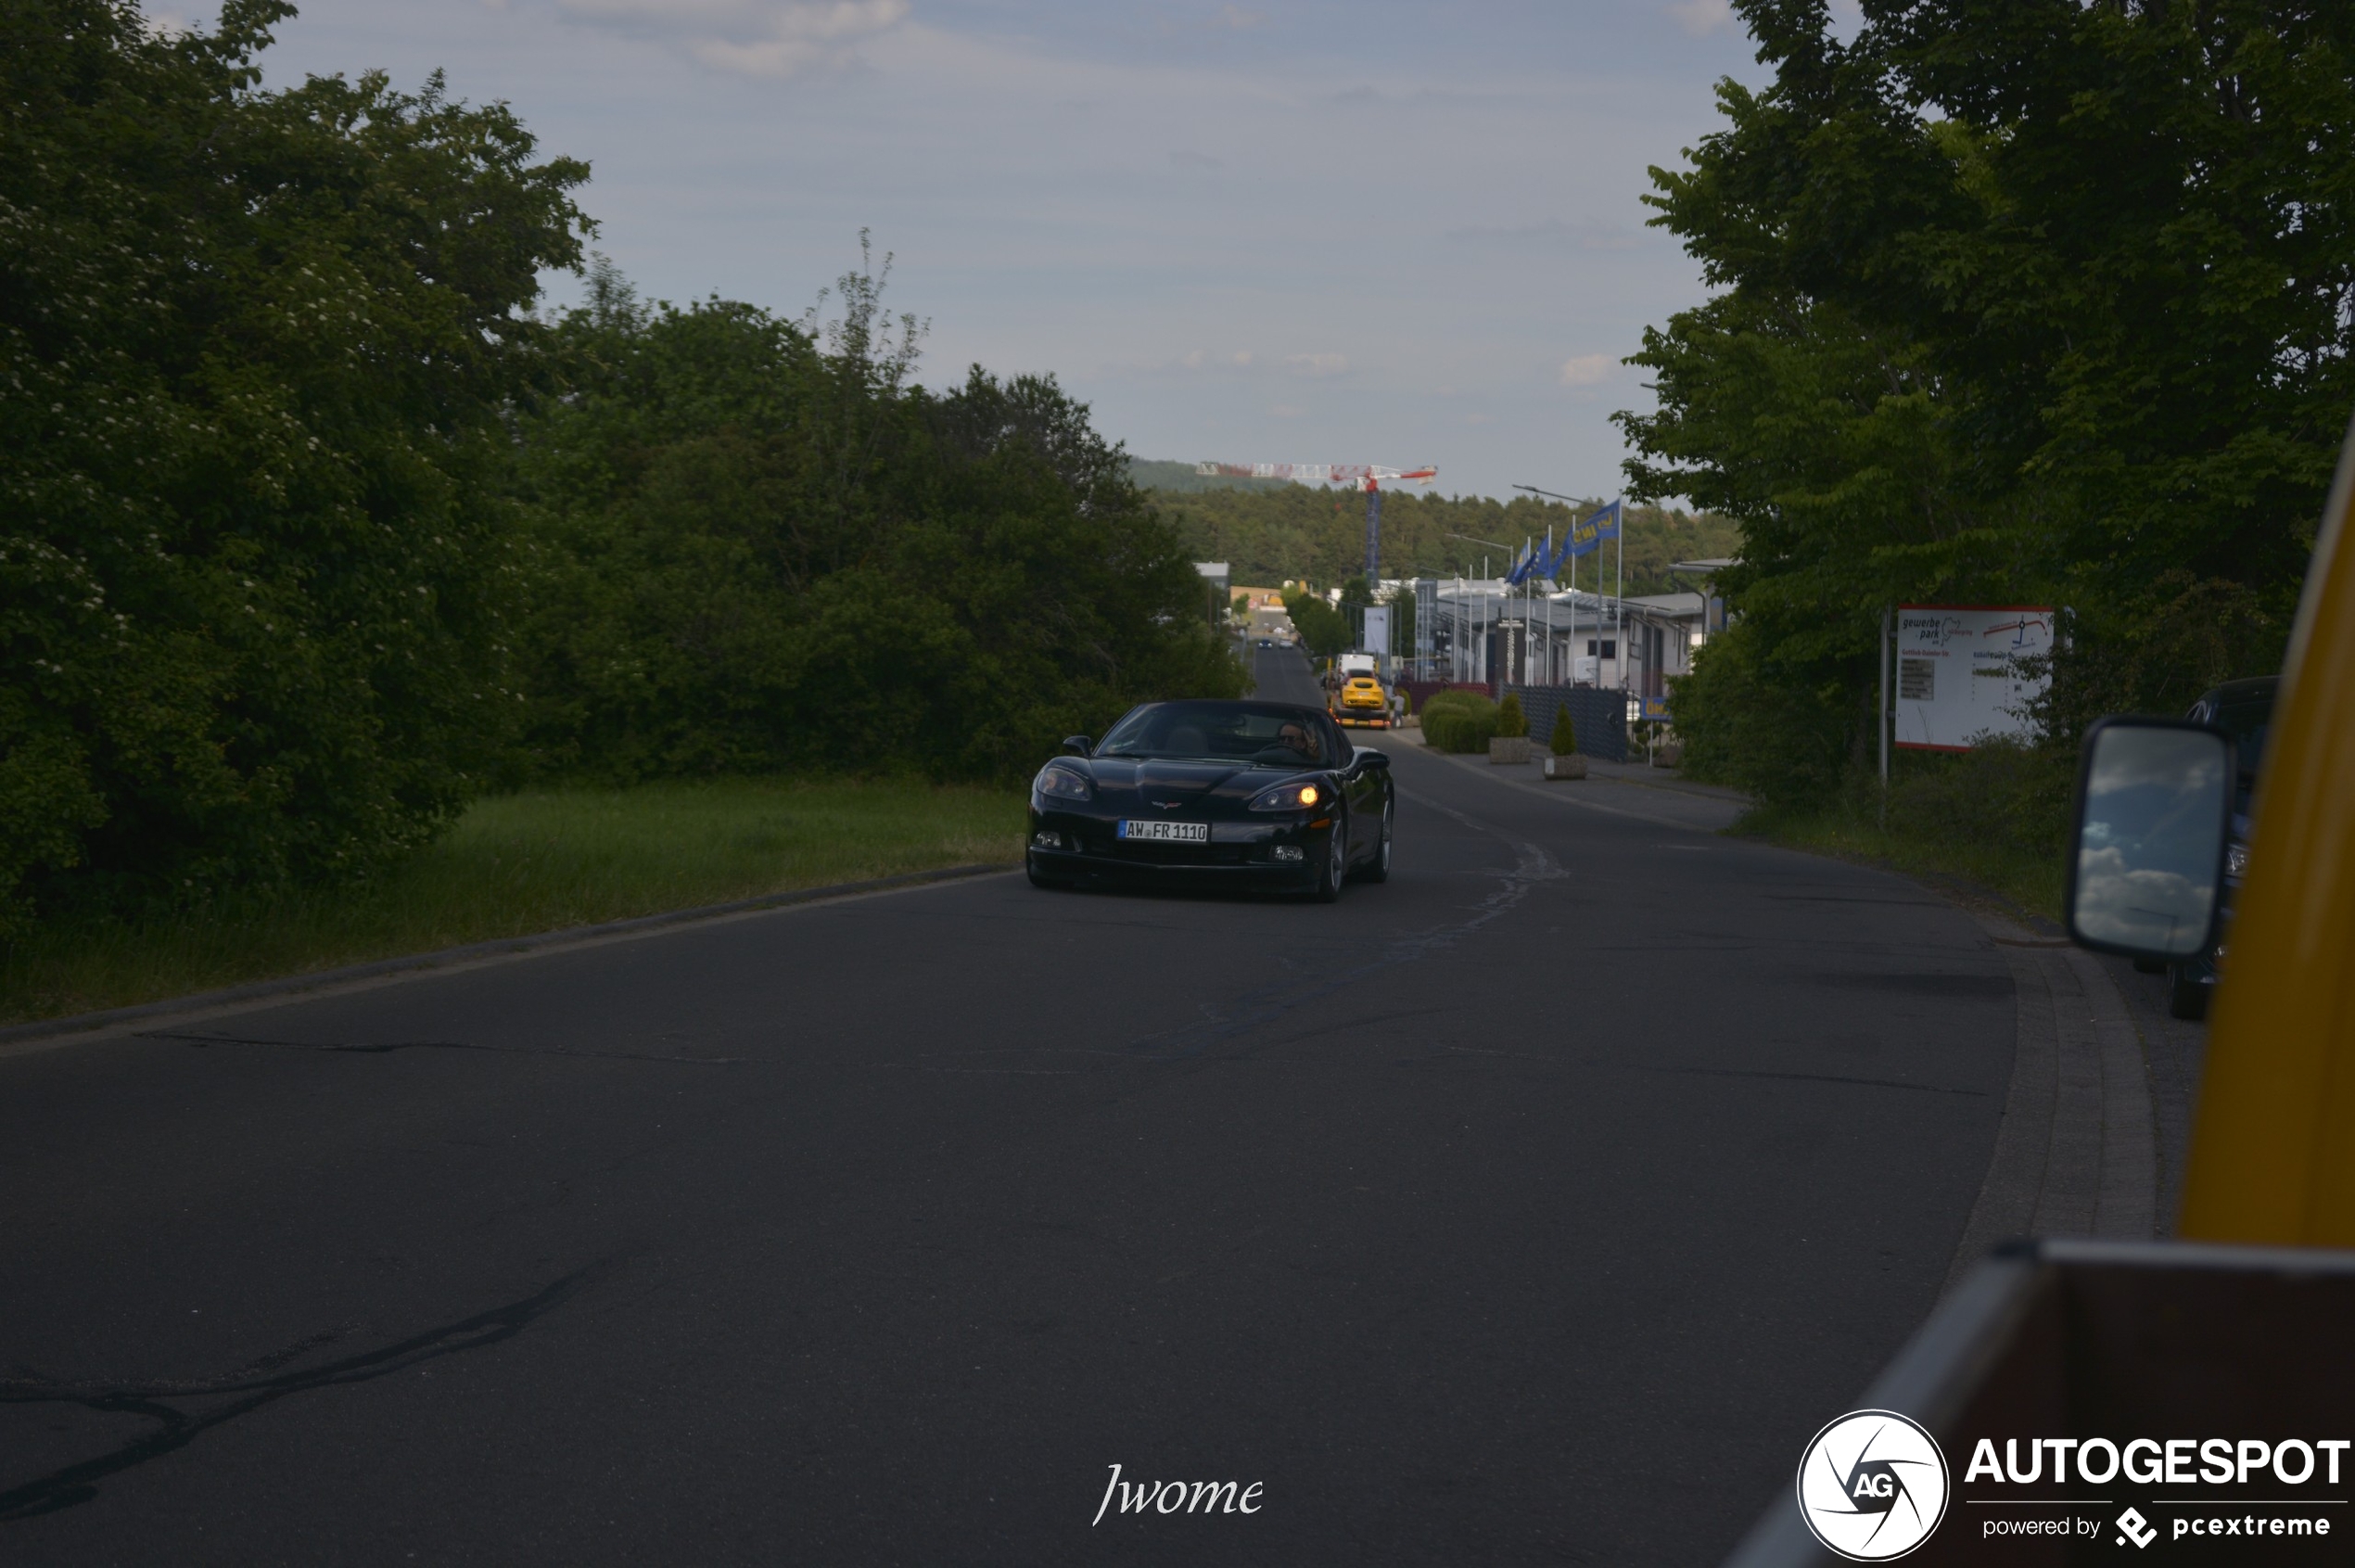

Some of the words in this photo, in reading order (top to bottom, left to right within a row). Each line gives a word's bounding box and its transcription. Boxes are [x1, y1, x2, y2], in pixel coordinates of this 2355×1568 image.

[1903, 617, 1941, 630] gewerbe
[1919, 628, 1940, 641] park
[1127, 822, 1144, 836] AW
[1153, 823, 1169, 838] FR
[1173, 824, 1206, 840] 1110
